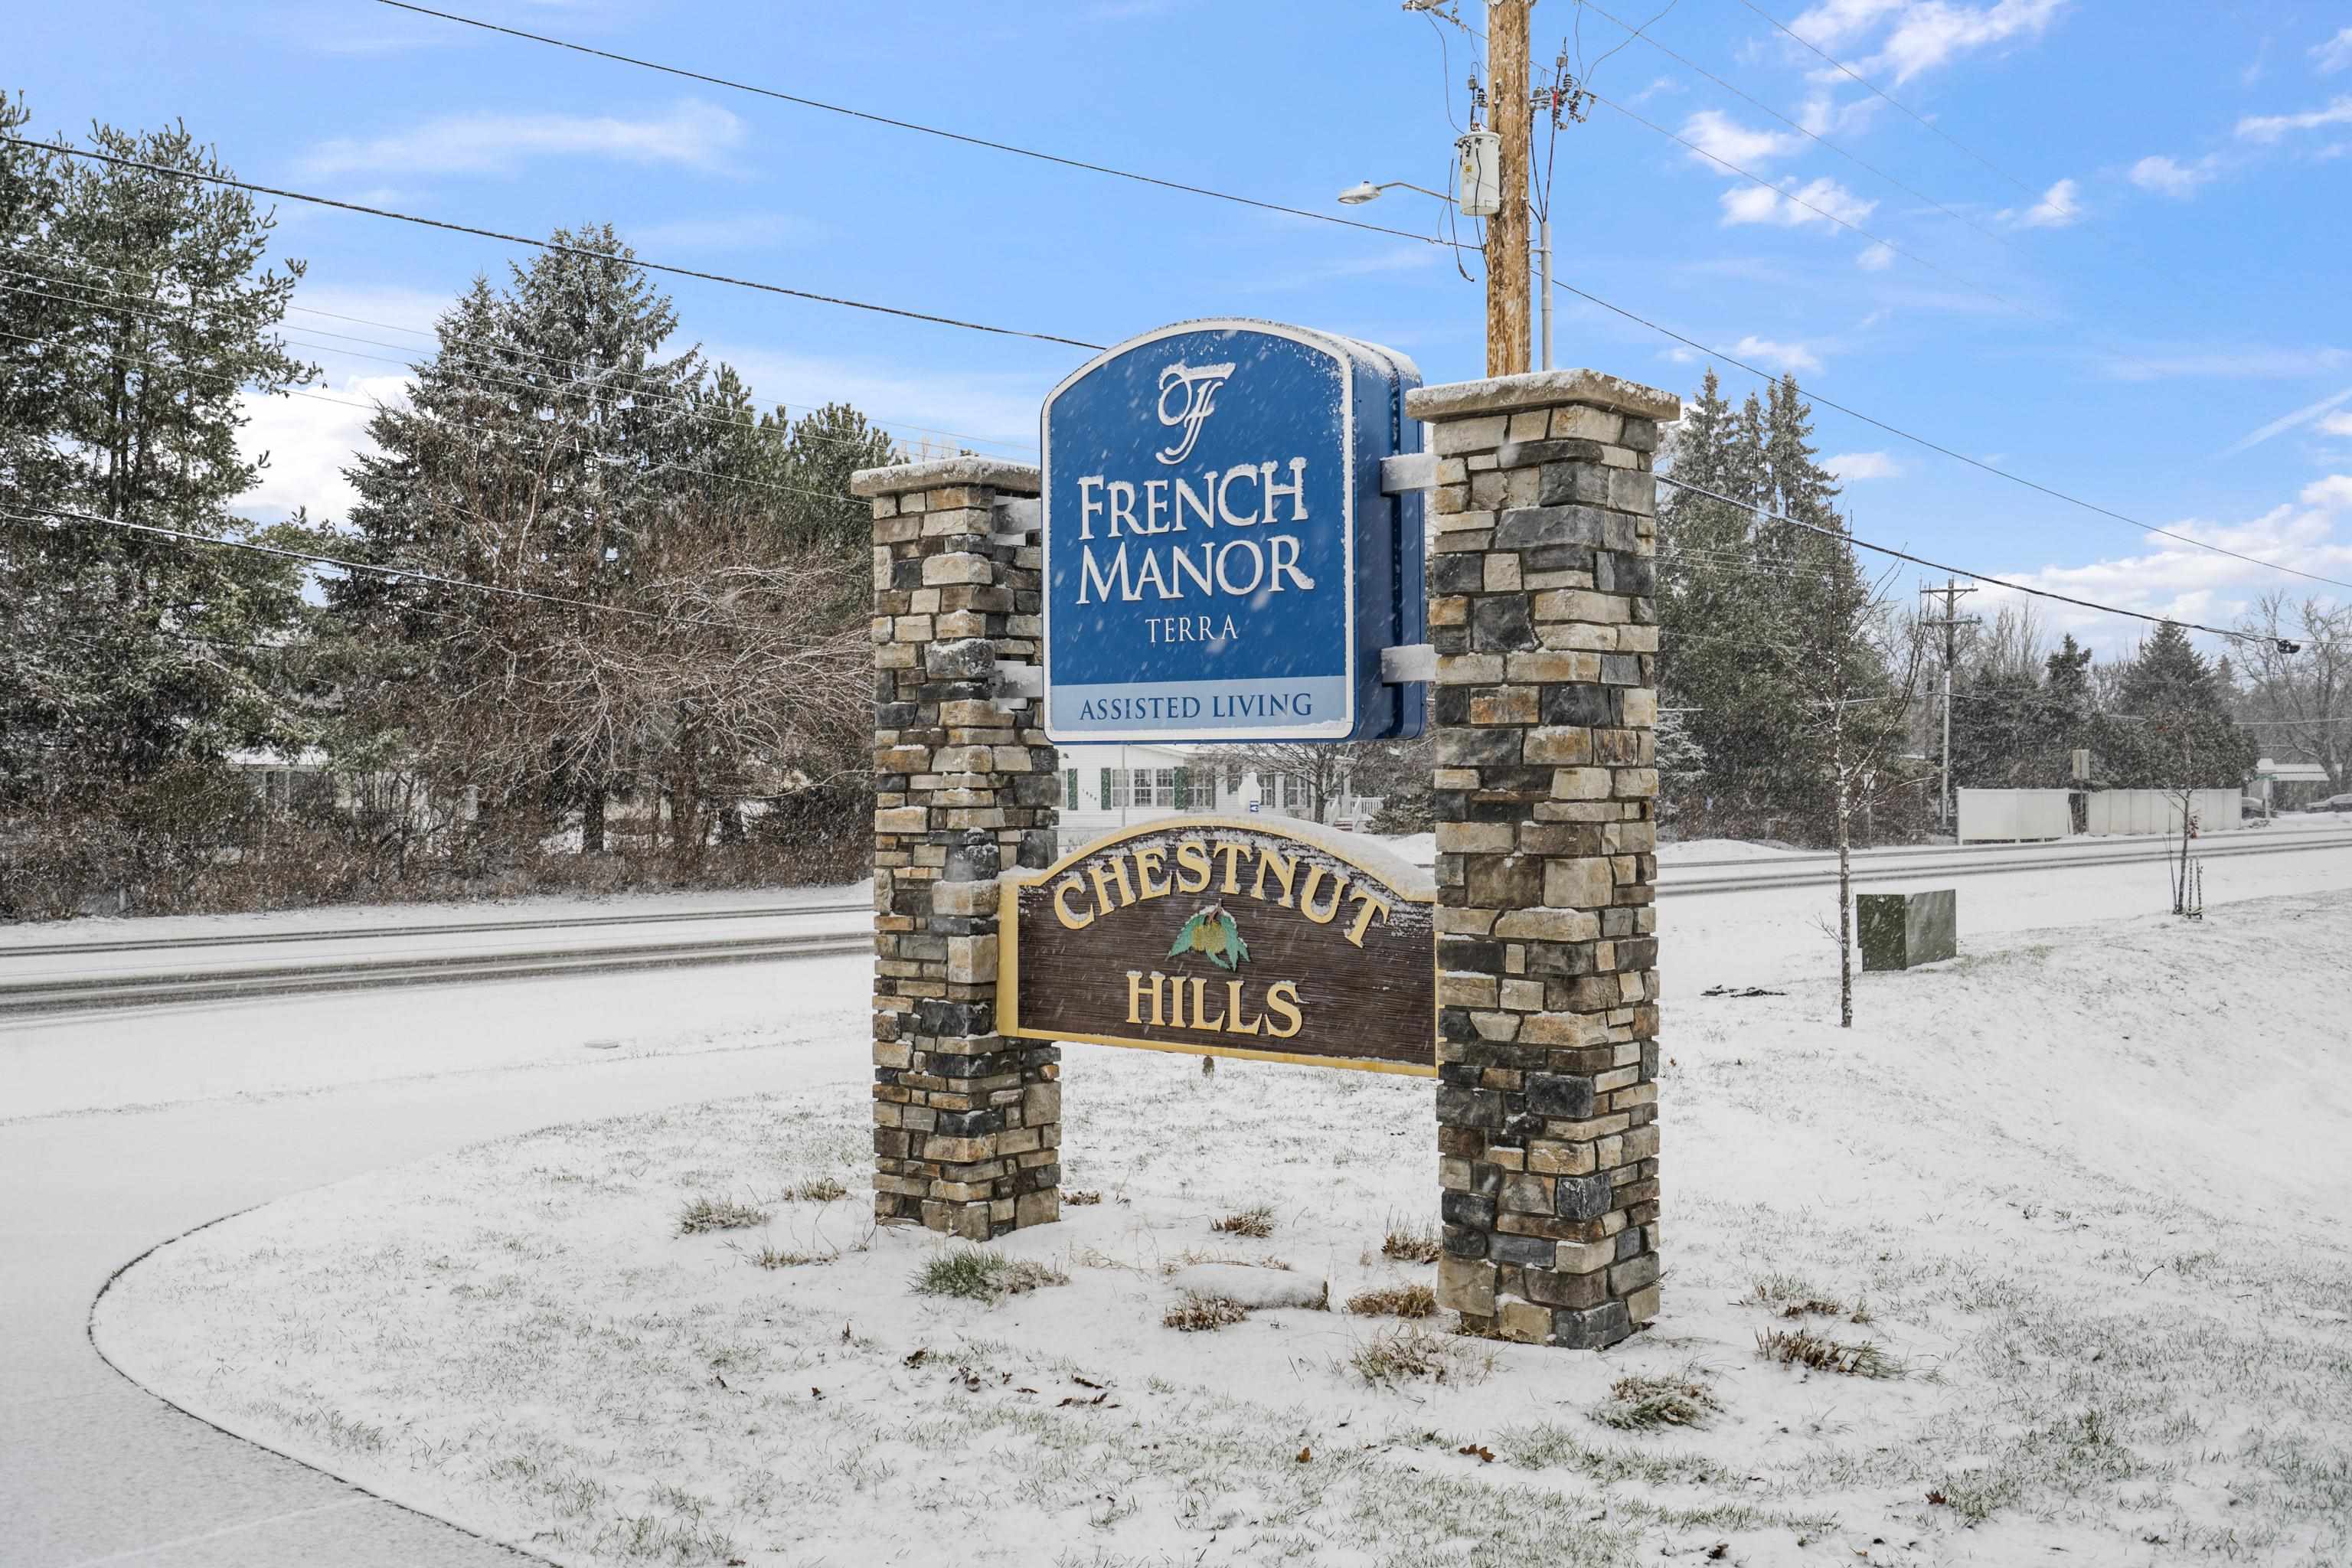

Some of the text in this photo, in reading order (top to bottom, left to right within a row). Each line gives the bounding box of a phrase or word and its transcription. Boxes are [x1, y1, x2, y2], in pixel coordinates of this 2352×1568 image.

[1076, 456, 1308, 541] FRENCH
[1076, 534, 1315, 605] MANOR
[1145, 614, 1238, 643] TERRA
[1079, 692, 1312, 721] ASSISTED LIVING
[1054, 841, 1390, 949] CHESTNUT
[1125, 970, 1303, 1037] HILLS
